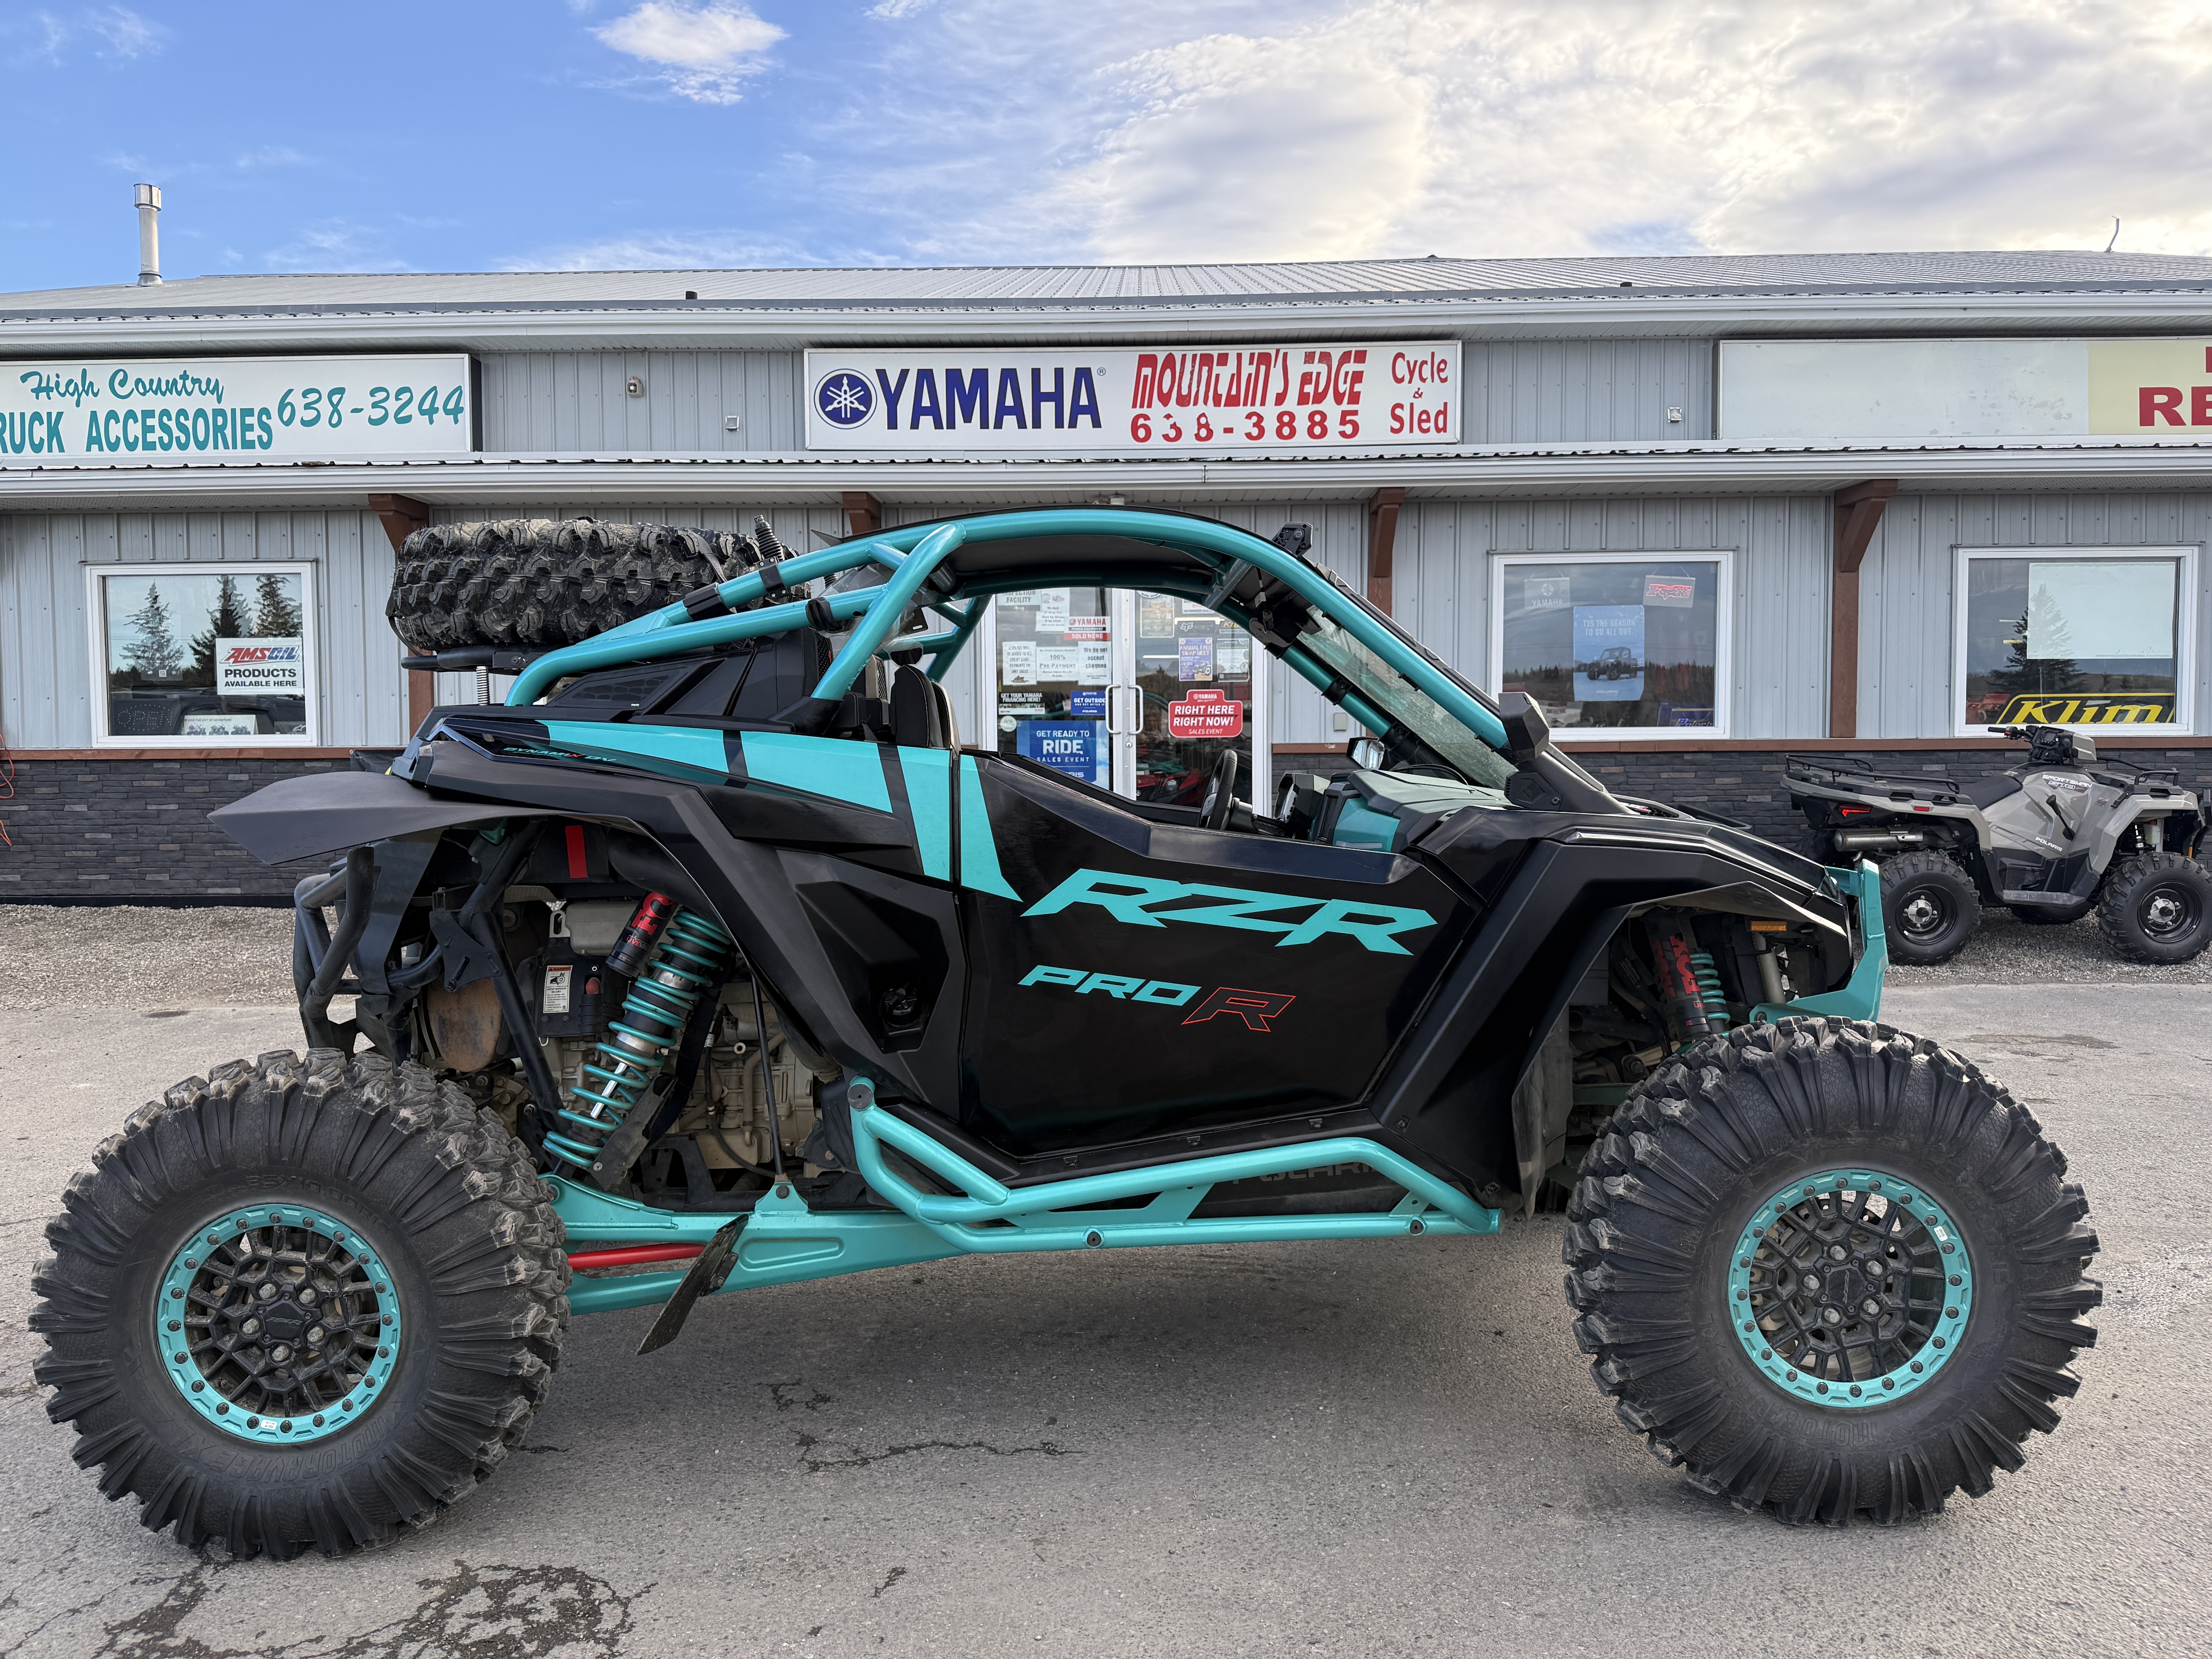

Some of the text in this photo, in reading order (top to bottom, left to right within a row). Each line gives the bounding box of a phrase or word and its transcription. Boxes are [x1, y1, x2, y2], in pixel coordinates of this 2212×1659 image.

[1391, 352, 1448, 384] Cycle
[20, 368, 224, 407] High Country
[1132, 349, 1367, 409] MOUNTAIN'S EDGE
[876, 368, 1103, 430] YAMAHA
[1412, 387, 1423, 399] &
[277, 385, 465, 428] 638-3244
[1131, 409, 1360, 443] 638-3885
[1390, 402, 1448, 434] Sled
[86, 407, 273, 452] ACCESSORIES
[1532, 599, 1563, 608] YAMAHA
[1610, 619, 1635, 627] SEASON
[222, 647, 298, 665] AMSOIL
[225, 669, 297, 678] PRODUCTS
[117, 708, 173, 726] OPEN
[1175, 705, 1235, 715] RIGHT HERE
[2006, 700, 2163, 724] Klim
[1173, 717, 1234, 726] RIGHT NOW!
[503, 747, 587, 758] DYNAMIX
[1043, 739, 1084, 754] RIDE
[2042, 775, 2092, 788] SPORTSMAN
[2035, 836, 2063, 852] POLARIS
[1020, 868, 1438, 956] RZR
[1018, 965, 1296, 1032] PRO R
